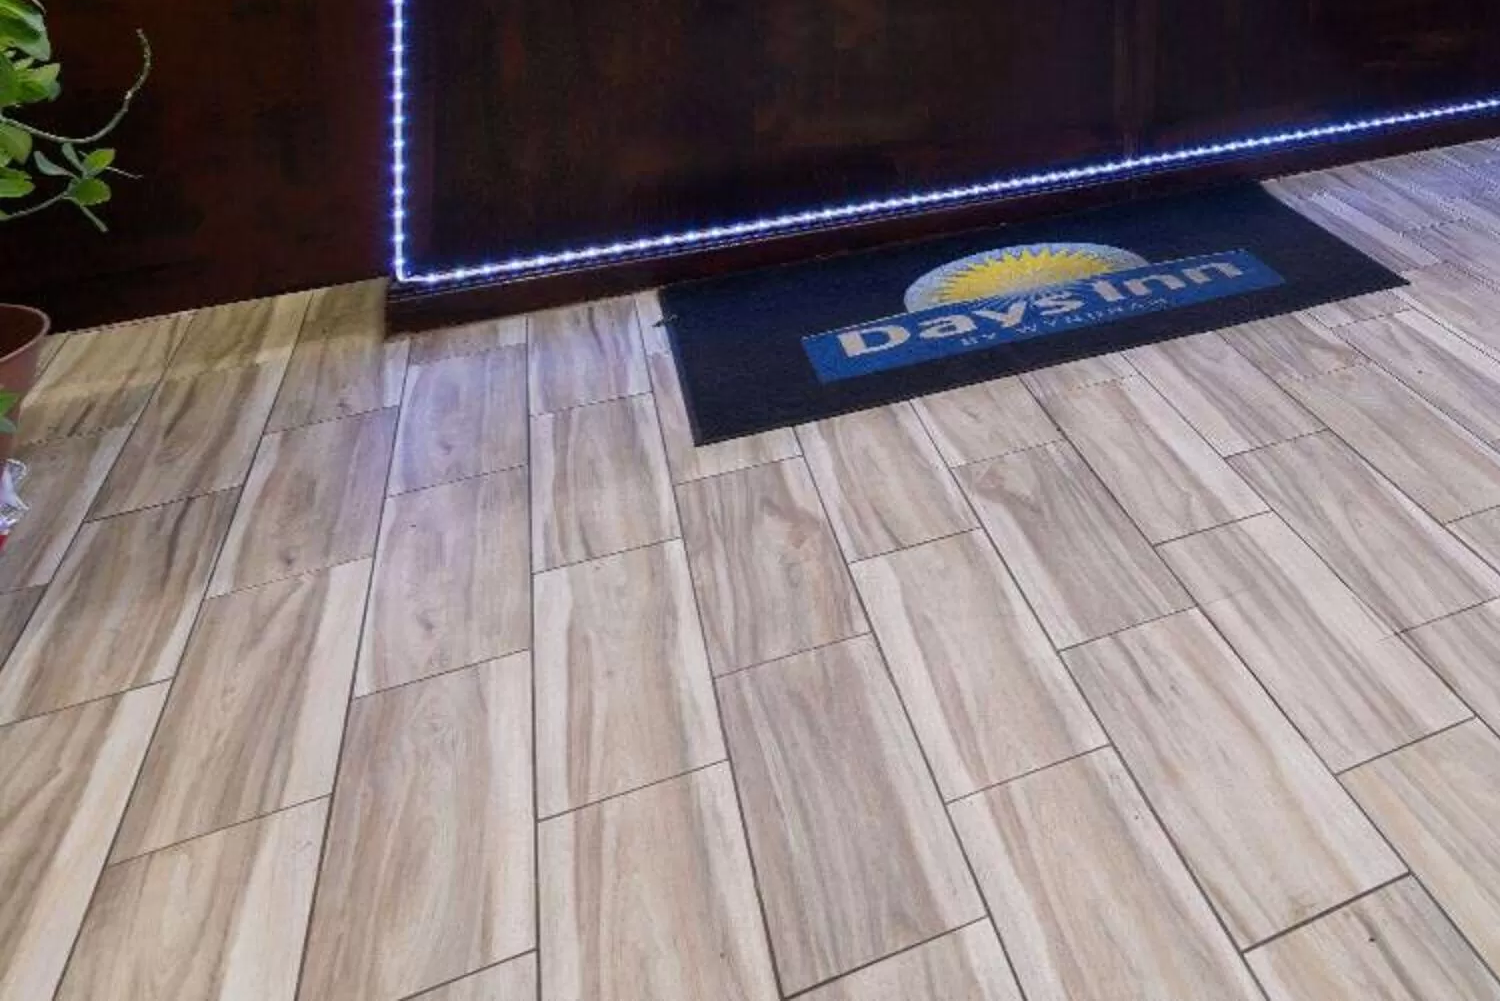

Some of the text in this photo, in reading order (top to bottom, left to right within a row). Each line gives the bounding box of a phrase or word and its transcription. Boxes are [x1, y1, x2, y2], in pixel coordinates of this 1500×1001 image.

[837, 262, 1243, 358] Days Inn
[961, 332, 996, 346] BY
